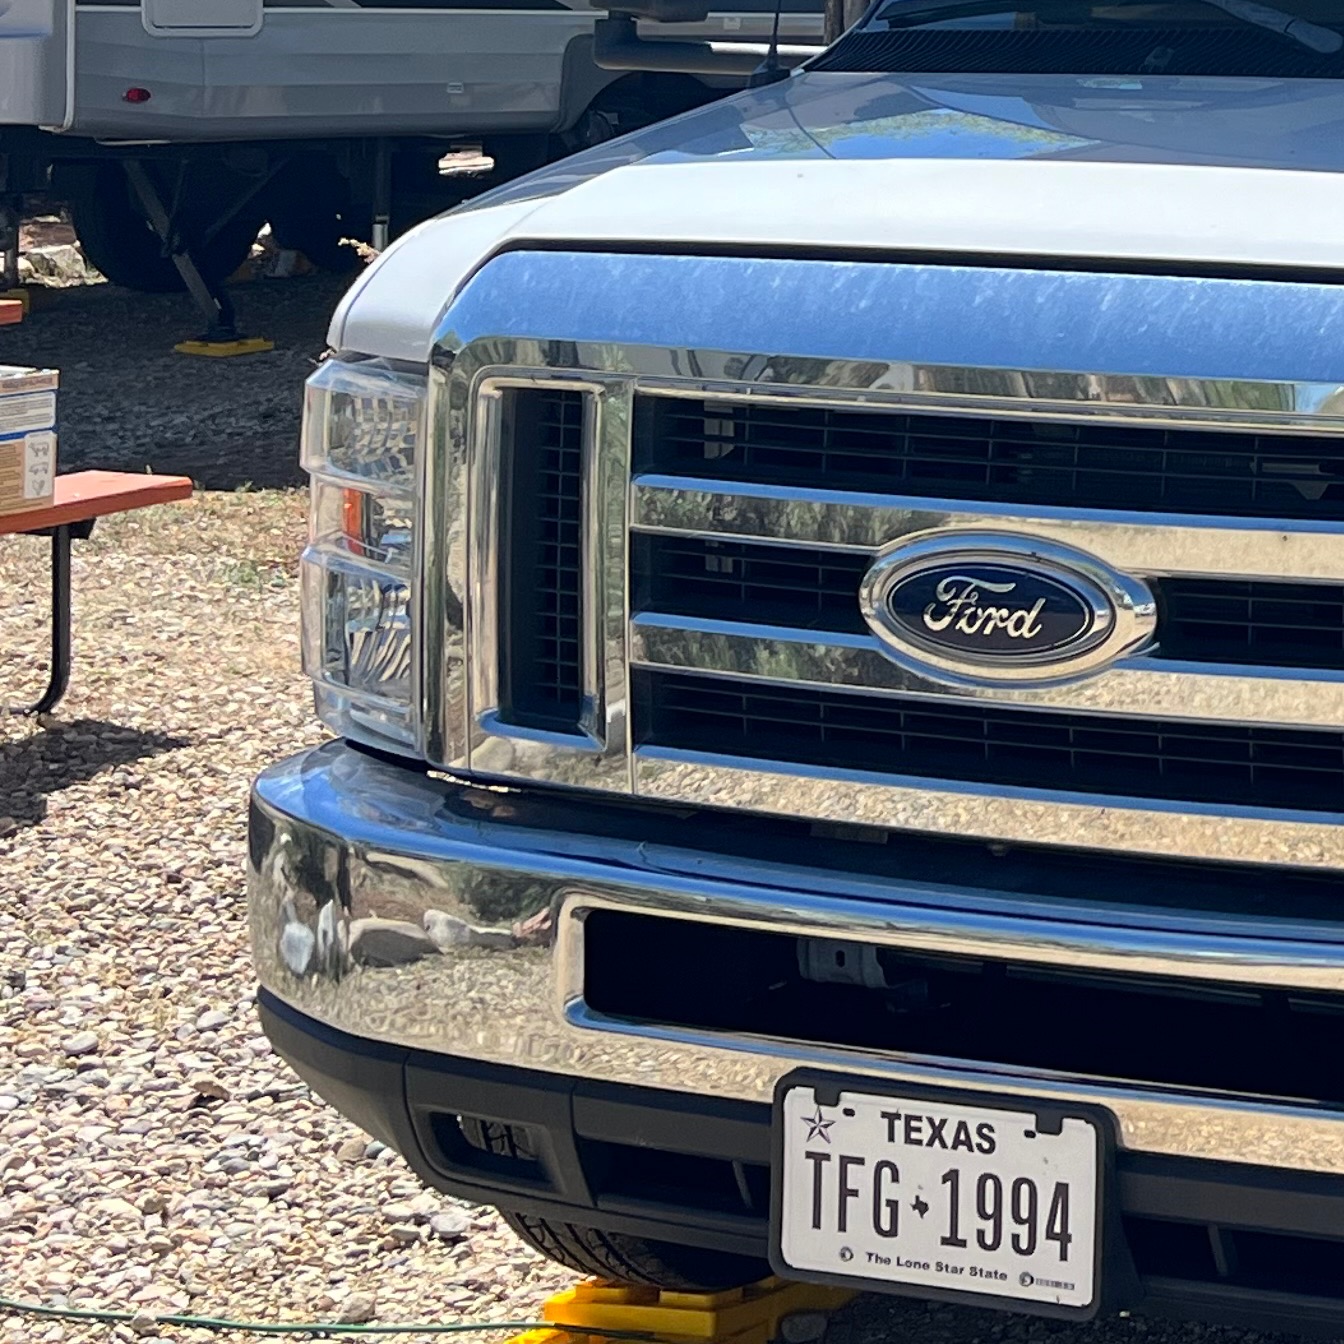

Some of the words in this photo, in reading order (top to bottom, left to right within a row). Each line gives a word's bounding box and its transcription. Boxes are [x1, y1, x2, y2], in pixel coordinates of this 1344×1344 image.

[923, 575, 1047, 639] Ford
[880, 1110, 997, 1155] TEXAS
[804, 1150, 900, 1239] TFG
[939, 1168, 1073, 1263] 1994
[865, 1251, 892, 1266] The
[896, 1256, 931, 1271] Lone
[934, 1262, 965, 1276] Star
[968, 1266, 1009, 1282] State
